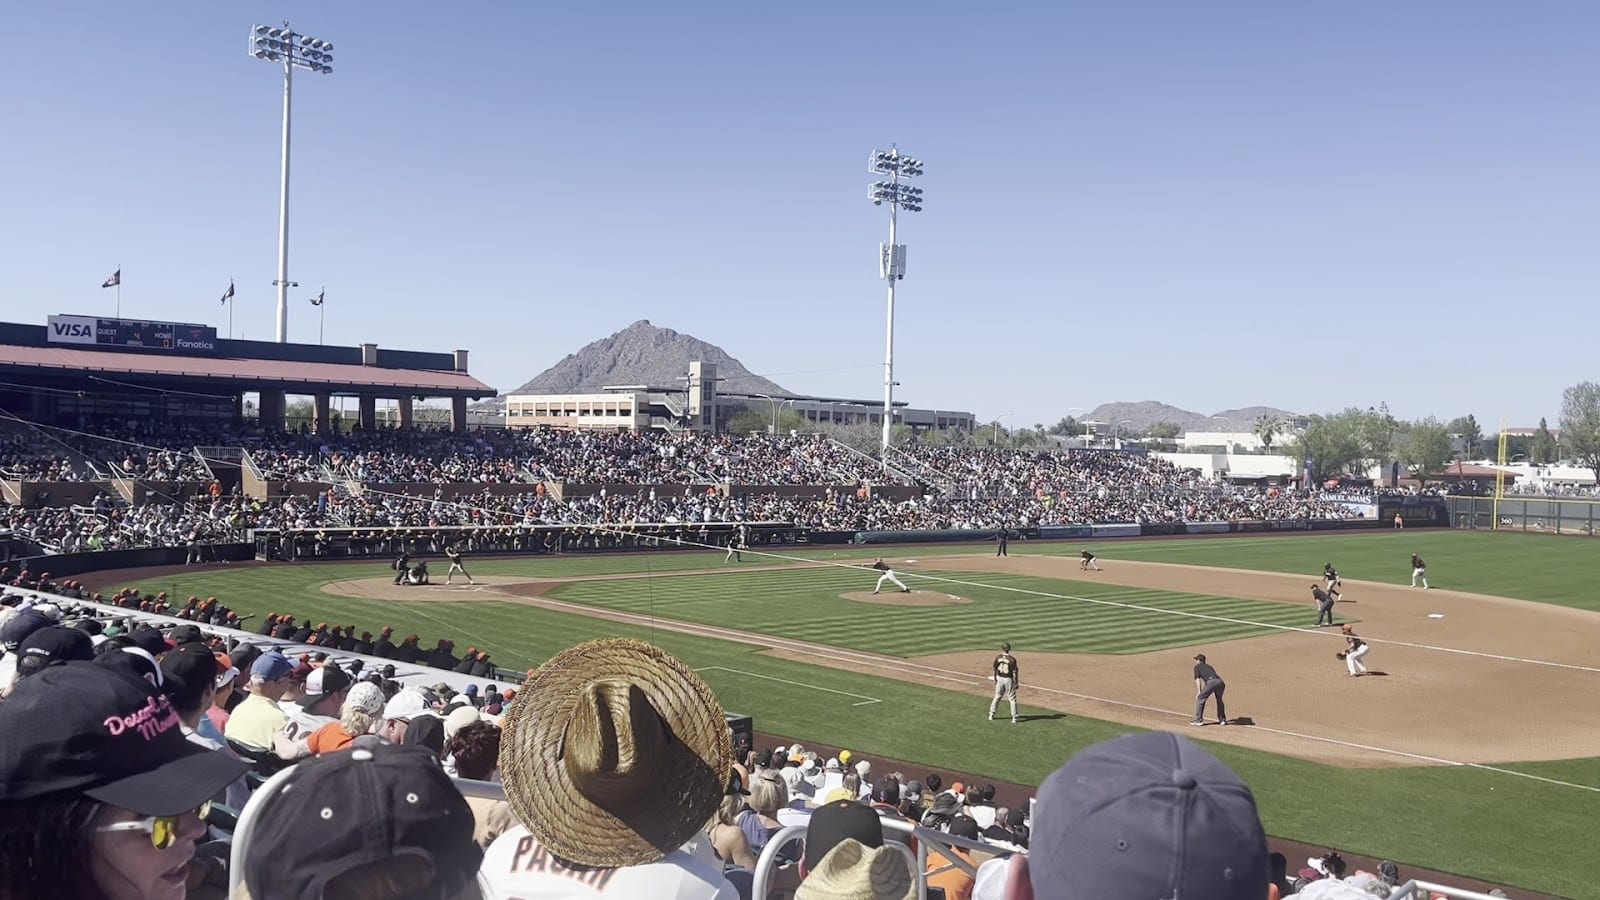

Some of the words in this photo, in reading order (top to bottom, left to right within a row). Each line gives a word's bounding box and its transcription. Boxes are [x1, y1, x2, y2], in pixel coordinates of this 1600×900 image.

[52, 322, 92, 337] VISA
[134, 332, 140, 340] 4
[163, 339, 169, 348] 0
[177, 339, 213, 349] Fanatics
[1319, 493, 1345, 501] SAMUEL
[1346, 495, 1371, 504] ADAMS
